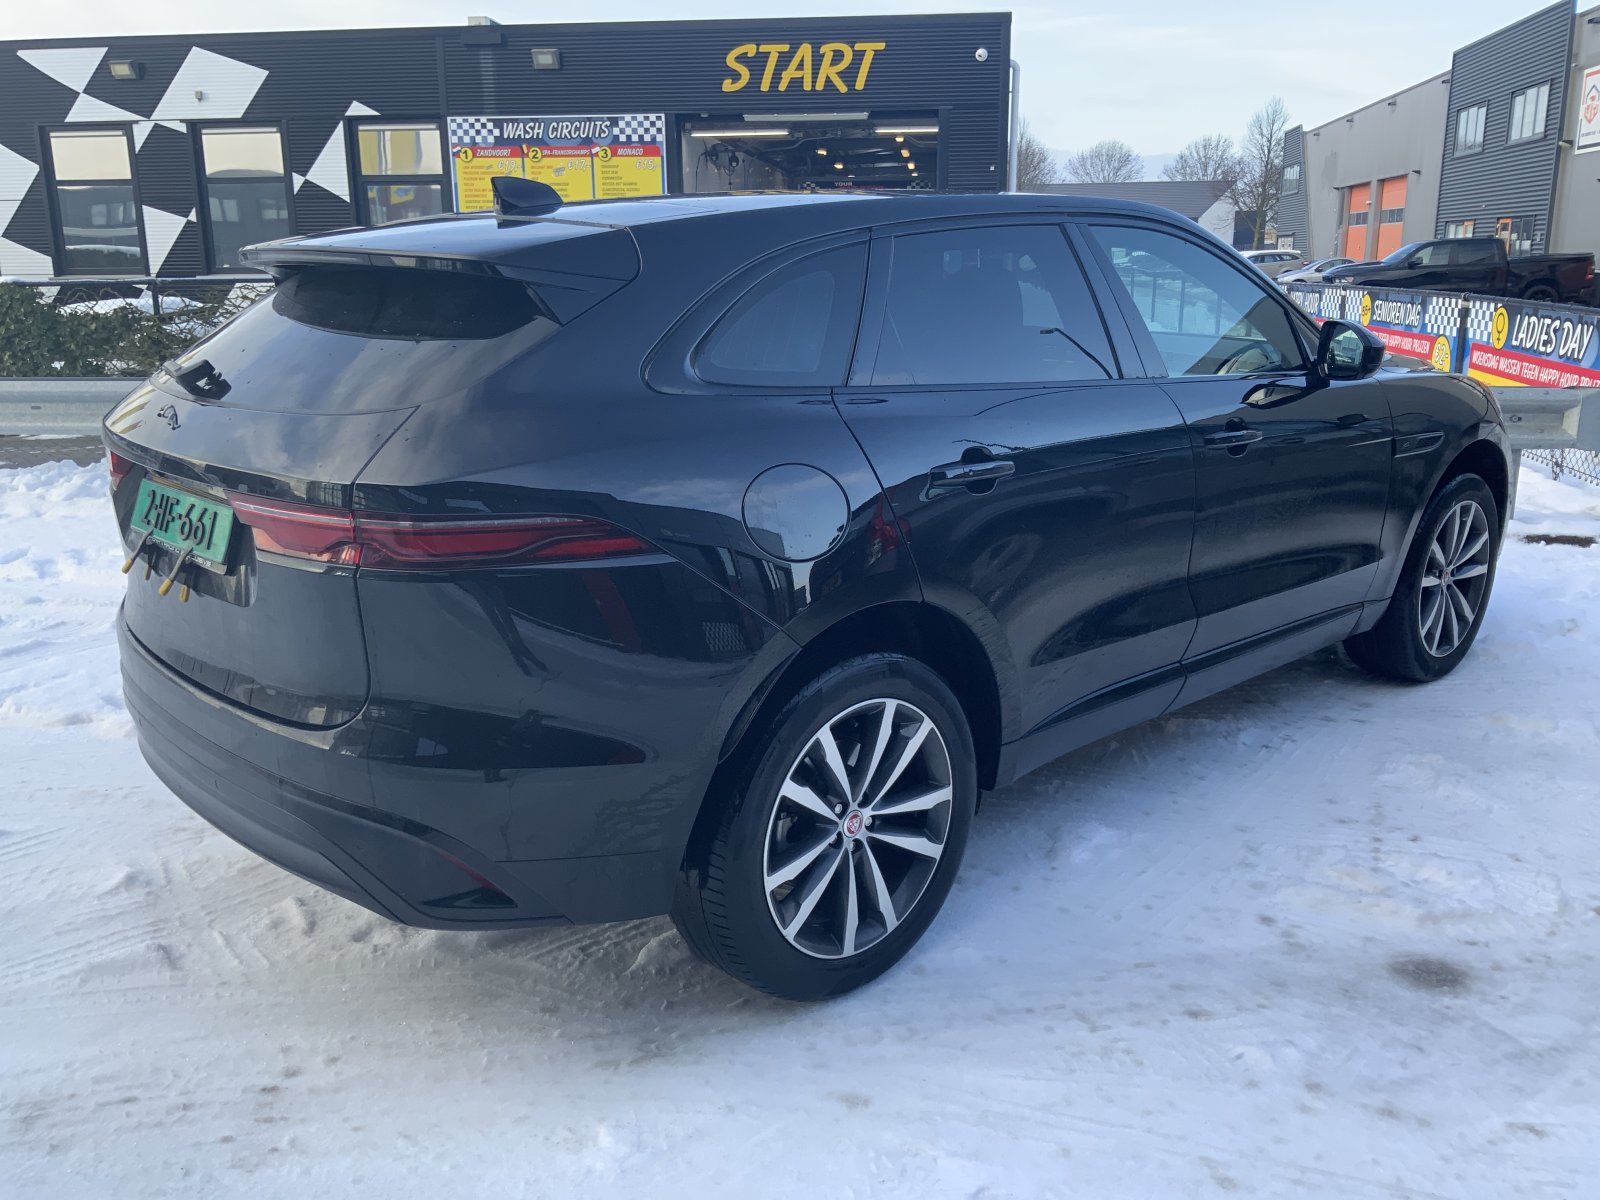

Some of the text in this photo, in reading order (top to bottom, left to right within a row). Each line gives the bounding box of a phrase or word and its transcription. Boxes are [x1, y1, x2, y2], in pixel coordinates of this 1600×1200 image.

[721, 41, 887, 94] START
[503, 121, 611, 139] WASH CIRCUITS
[476, 149, 511, 157] ZANDVOORT
[617, 148, 644, 156] MONACO
[1373, 300, 1422, 327] SENIOREN DAG
[1511, 314, 1594, 360] LADIES DAY
[1472, 350, 1500, 369] WOENSDAG
[1498, 356, 1522, 376] WASSEN
[1521, 362, 1541, 381] TEGEN
[1538, 367, 1561, 386] HAPPY
